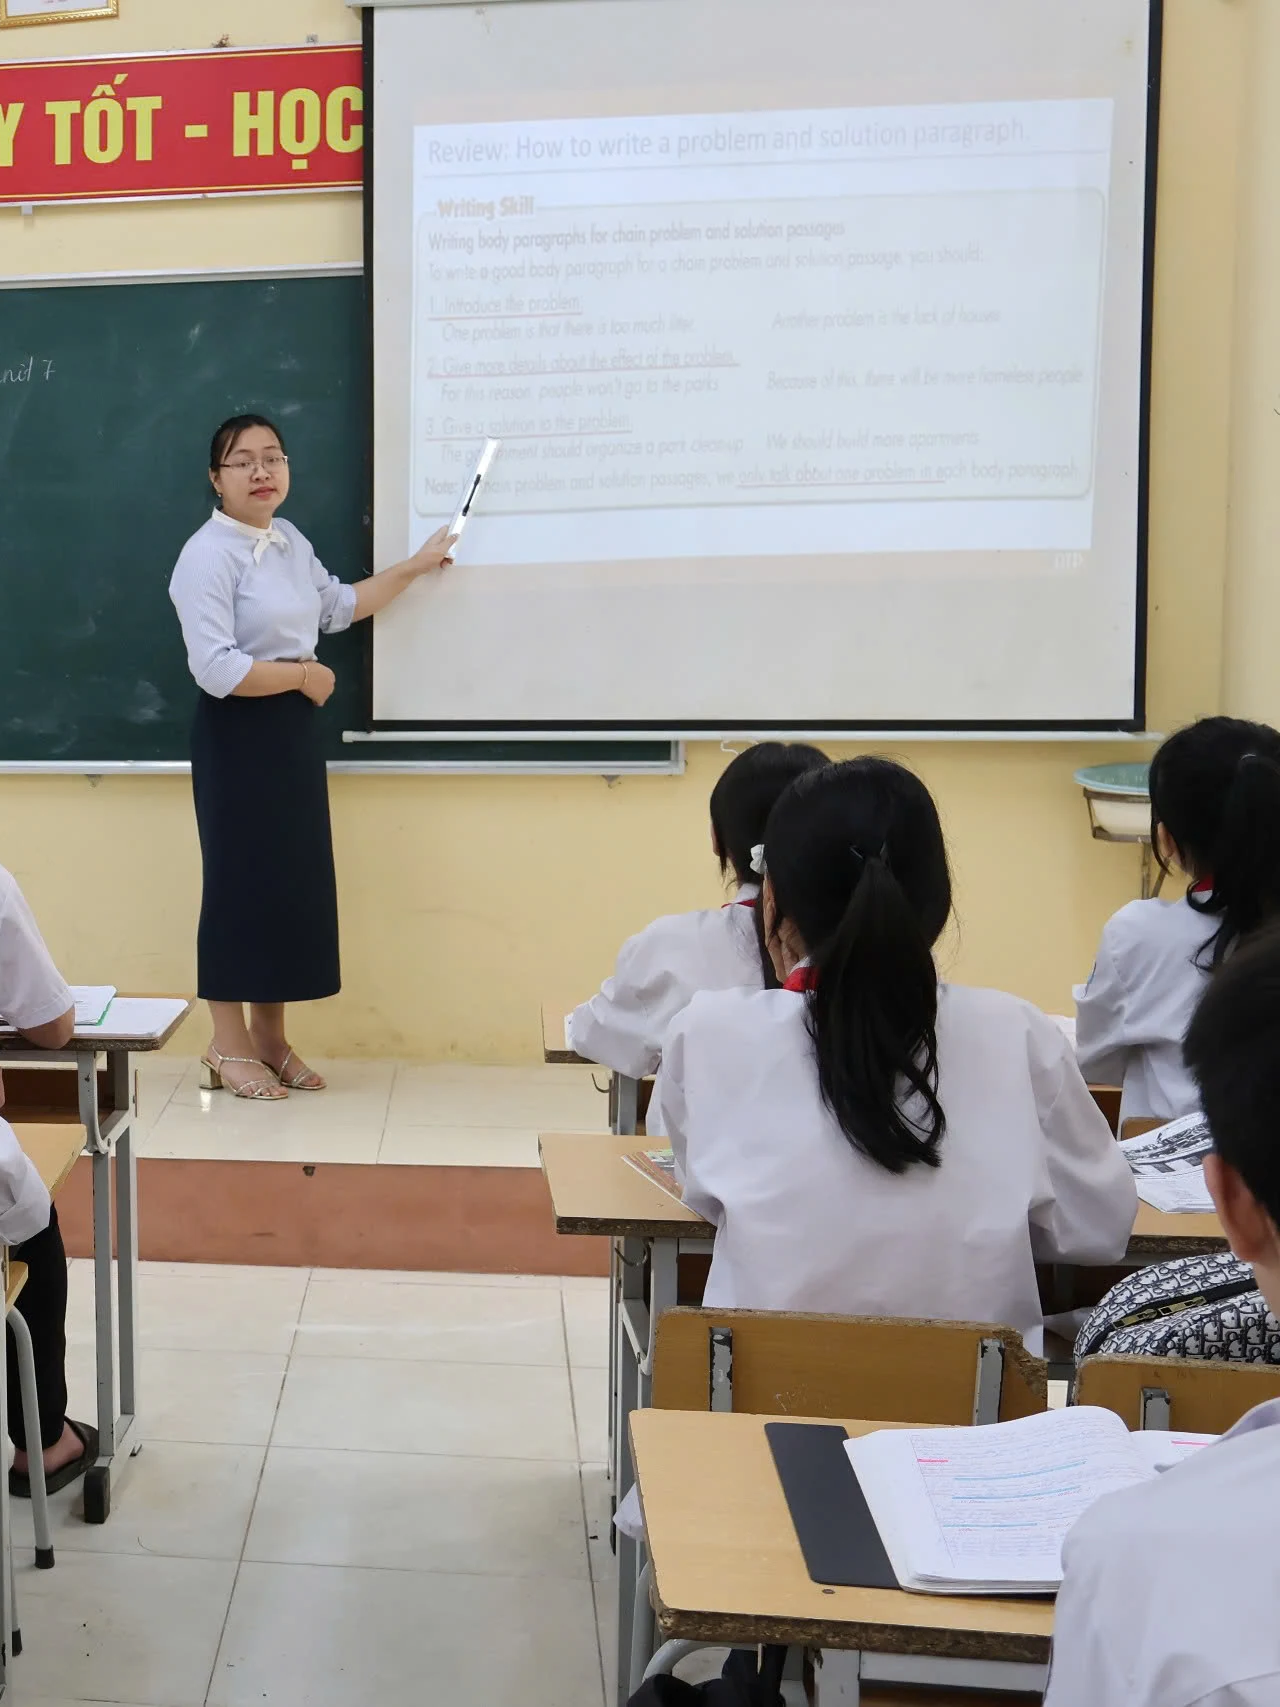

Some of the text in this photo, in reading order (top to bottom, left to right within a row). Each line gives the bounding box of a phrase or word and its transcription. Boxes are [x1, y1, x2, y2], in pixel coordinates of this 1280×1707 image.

[45, 72, 162, 165] TỐT
[232, 85, 363, 175] HỌC
[516, 136, 563, 160] How
[570, 136, 592, 157] to
[598, 132, 652, 157] write
[658, 136, 670, 154] a
[677, 126, 766, 159] problem
[773, 124, 813, 150] and
[820, 121, 906, 148] solution
[437, 195, 535, 221] Writing Skill
[428, 231, 474, 255] Writing
[478, 229, 509, 251] body
[513, 223, 586, 251] paragraphs
[590, 222, 607, 244] for
[612, 221, 646, 243] chain
[650, 220, 701, 246] problem
[706, 220, 730, 240] and
[734, 218, 782, 239] solution
[43, 359, 56, 380] 7
